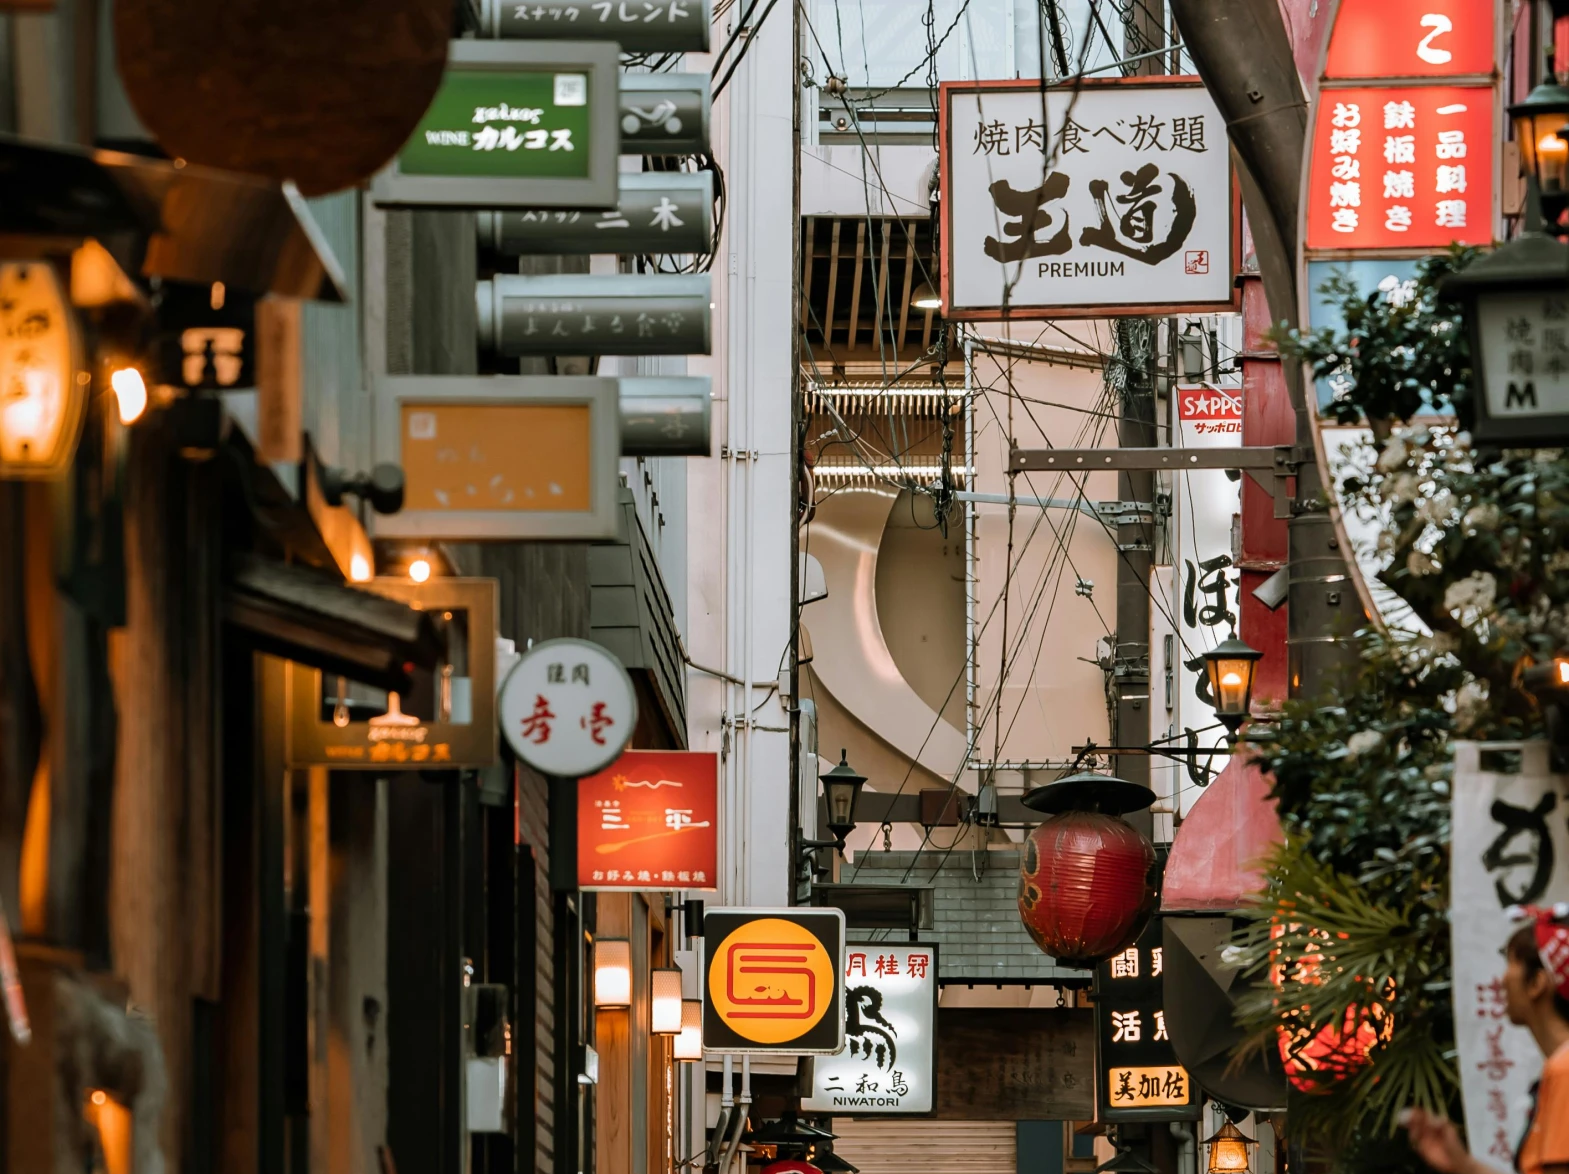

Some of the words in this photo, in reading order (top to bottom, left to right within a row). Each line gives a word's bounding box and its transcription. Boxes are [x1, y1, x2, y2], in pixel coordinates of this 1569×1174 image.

[514, 5, 579, 21] スナック
[591, 1, 689, 22] フレンド
[472, 125, 575, 151] カルコス
[973, 114, 1208, 155] 焼肉食べ放題
[1330, 103, 1361, 233] お好み焼き
[1383, 101, 1415, 232] 鉄板焼き
[1435, 103, 1467, 228] 一品料理
[984, 163, 1196, 266] 王道
[1038, 261, 1124, 277] PREMIUM
[845, 953, 929, 979] 月桂冠
[824, 1071, 909, 1097] 二和鳥
[1114, 1070, 1186, 1101] 美加佐
[833, 1097, 899, 1107] NIWATORI
